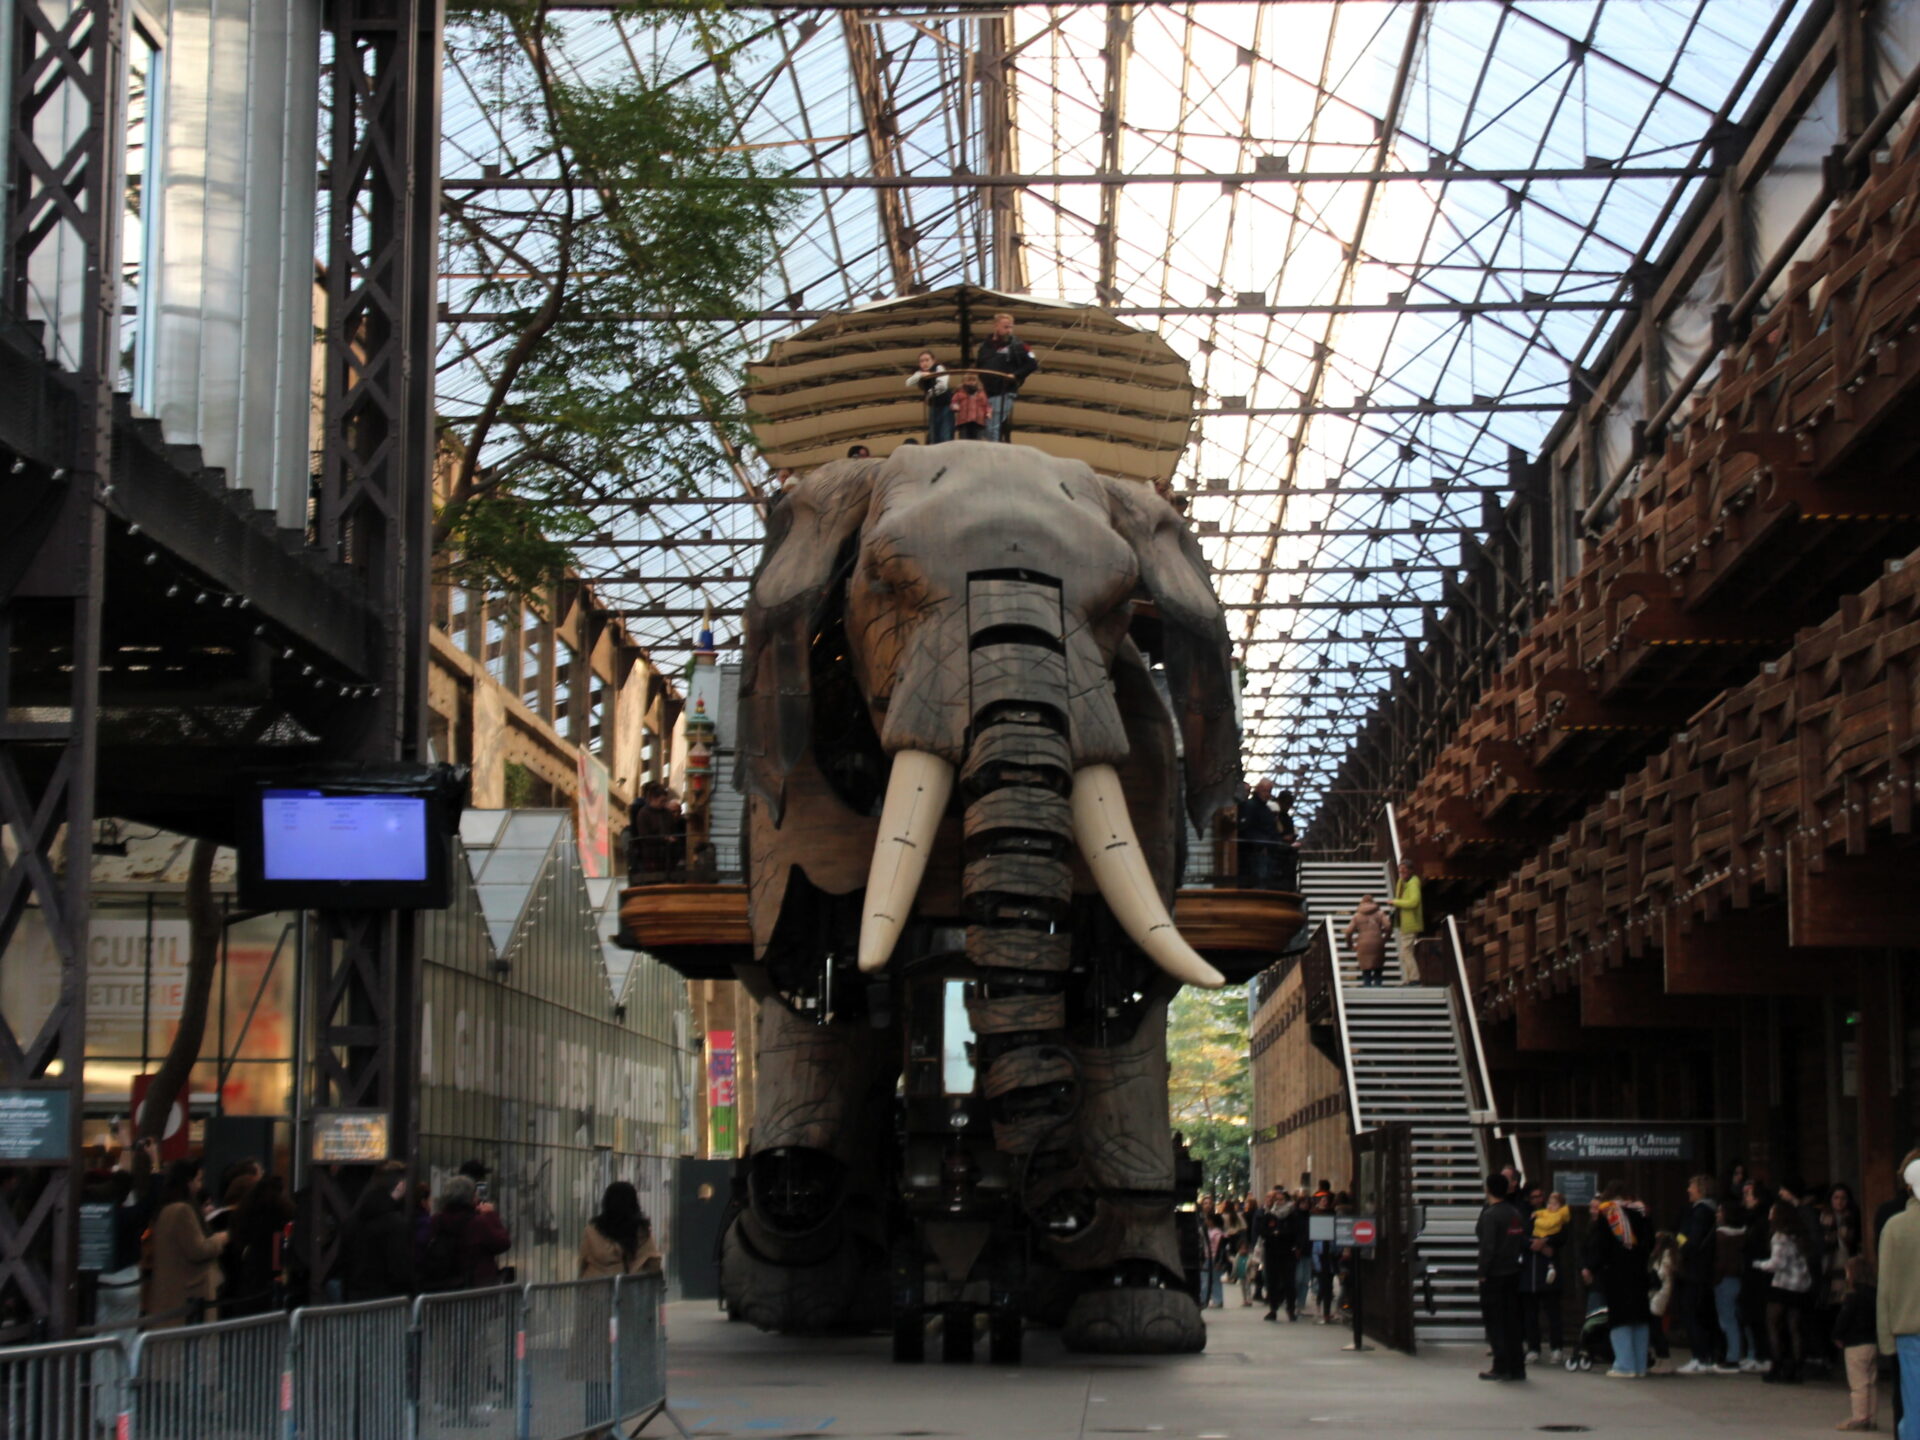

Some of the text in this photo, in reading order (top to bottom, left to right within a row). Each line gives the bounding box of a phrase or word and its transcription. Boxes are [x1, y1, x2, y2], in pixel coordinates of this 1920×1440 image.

[41, 936, 187, 968] ACUEIL
[1576, 1133, 1624, 1145] TERRASSES
[1588, 1145, 1628, 1156] BRANCHE
[1631, 1145, 1679, 1156] PROTOTYPE
